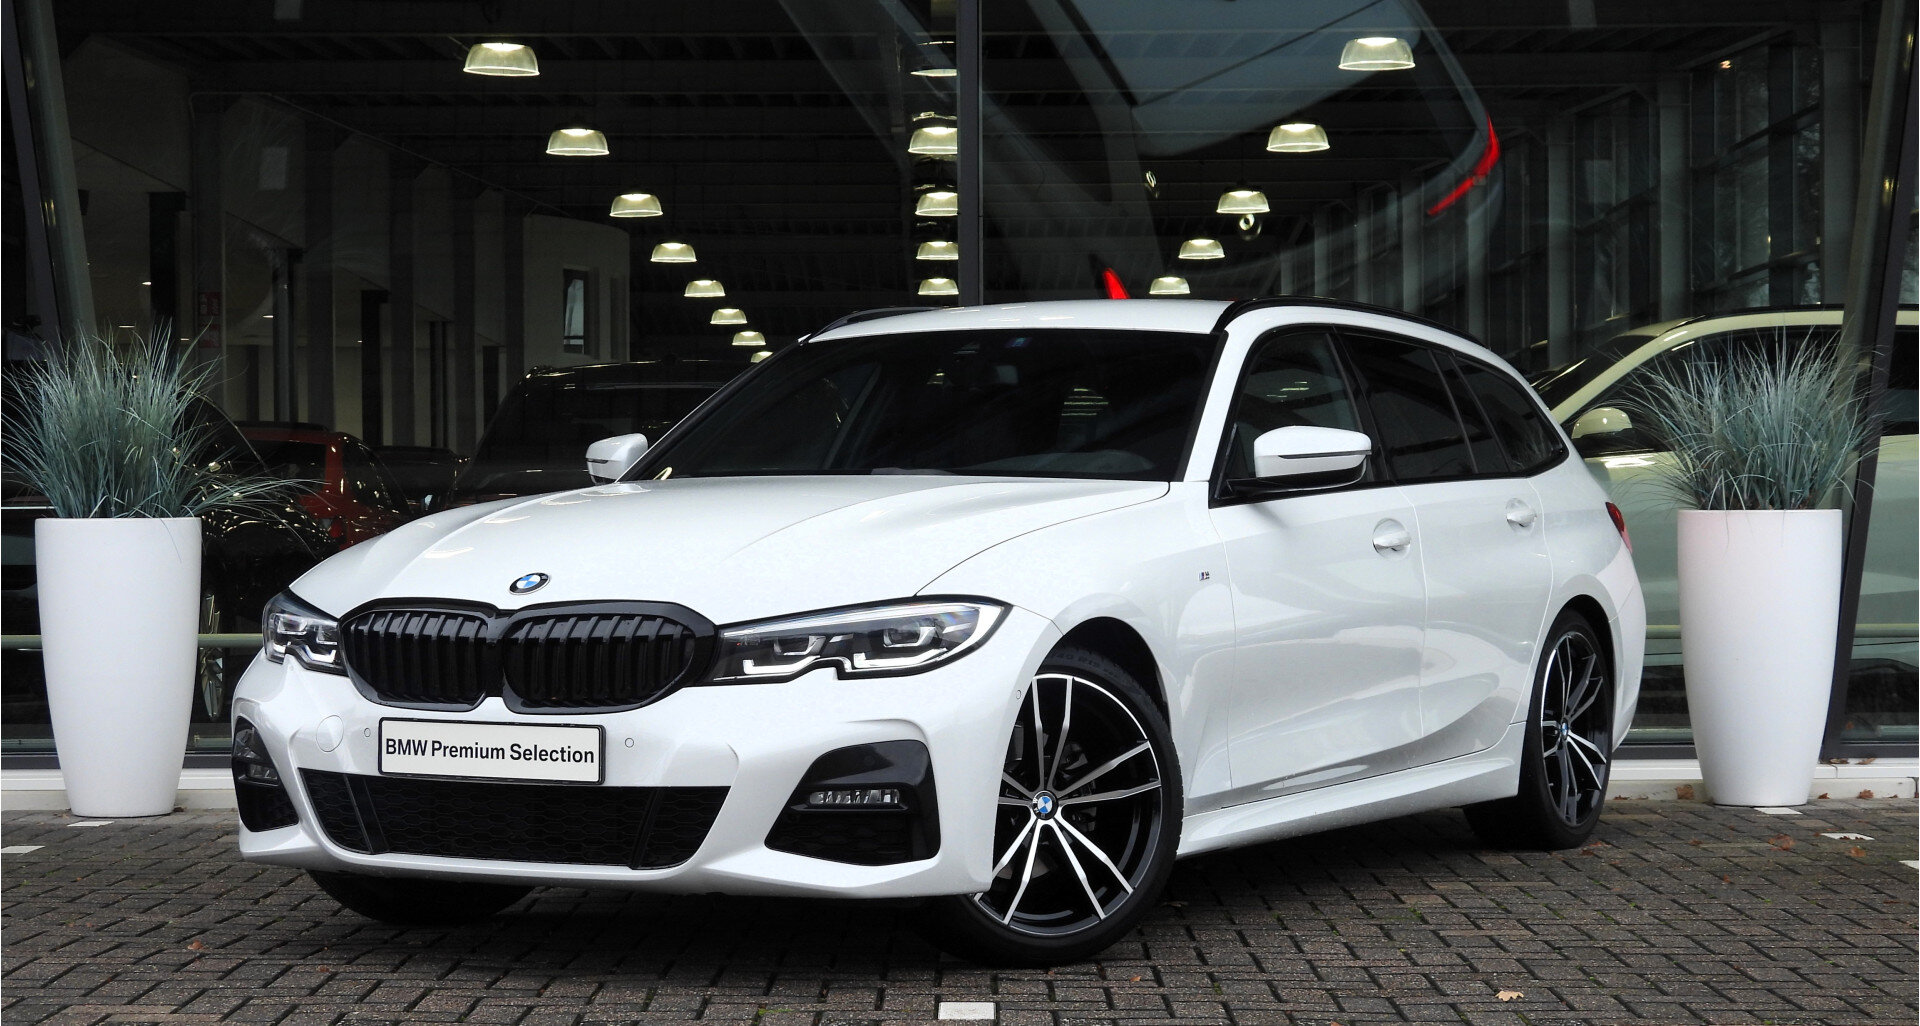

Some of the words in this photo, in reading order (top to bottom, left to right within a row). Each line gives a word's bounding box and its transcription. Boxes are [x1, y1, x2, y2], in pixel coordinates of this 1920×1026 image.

[385, 738, 428, 757] BMW
[431, 740, 505, 760] Premium
[509, 743, 594, 764] Selection
